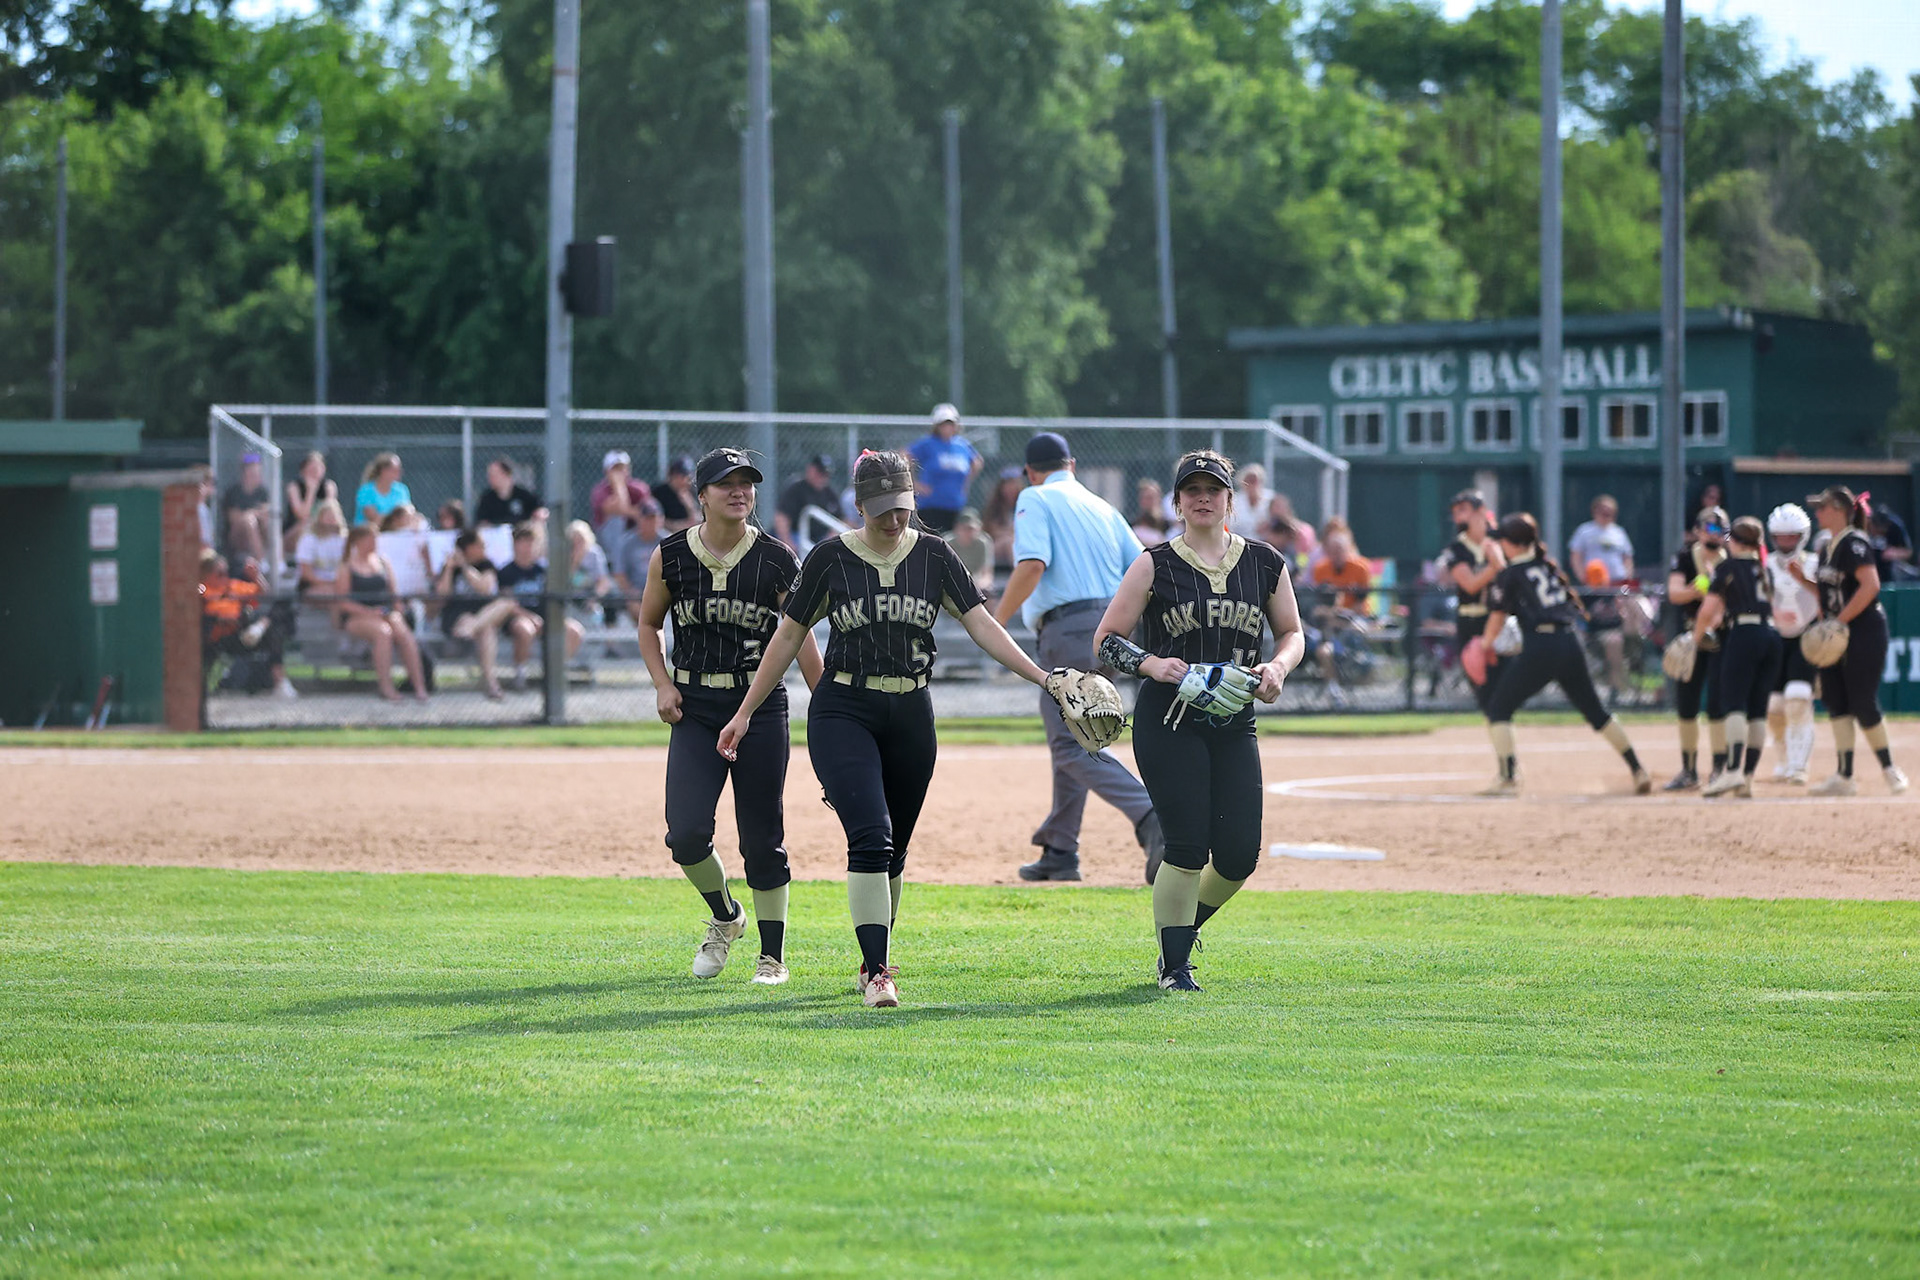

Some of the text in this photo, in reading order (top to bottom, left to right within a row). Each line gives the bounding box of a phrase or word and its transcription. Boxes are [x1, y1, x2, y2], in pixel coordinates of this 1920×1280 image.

[1329, 345, 1662, 398] CELTIC BASBALL
[673, 599, 702, 628] AK
[832, 593, 937, 634] OAK FORES
[1162, 601, 1202, 638] OAK
